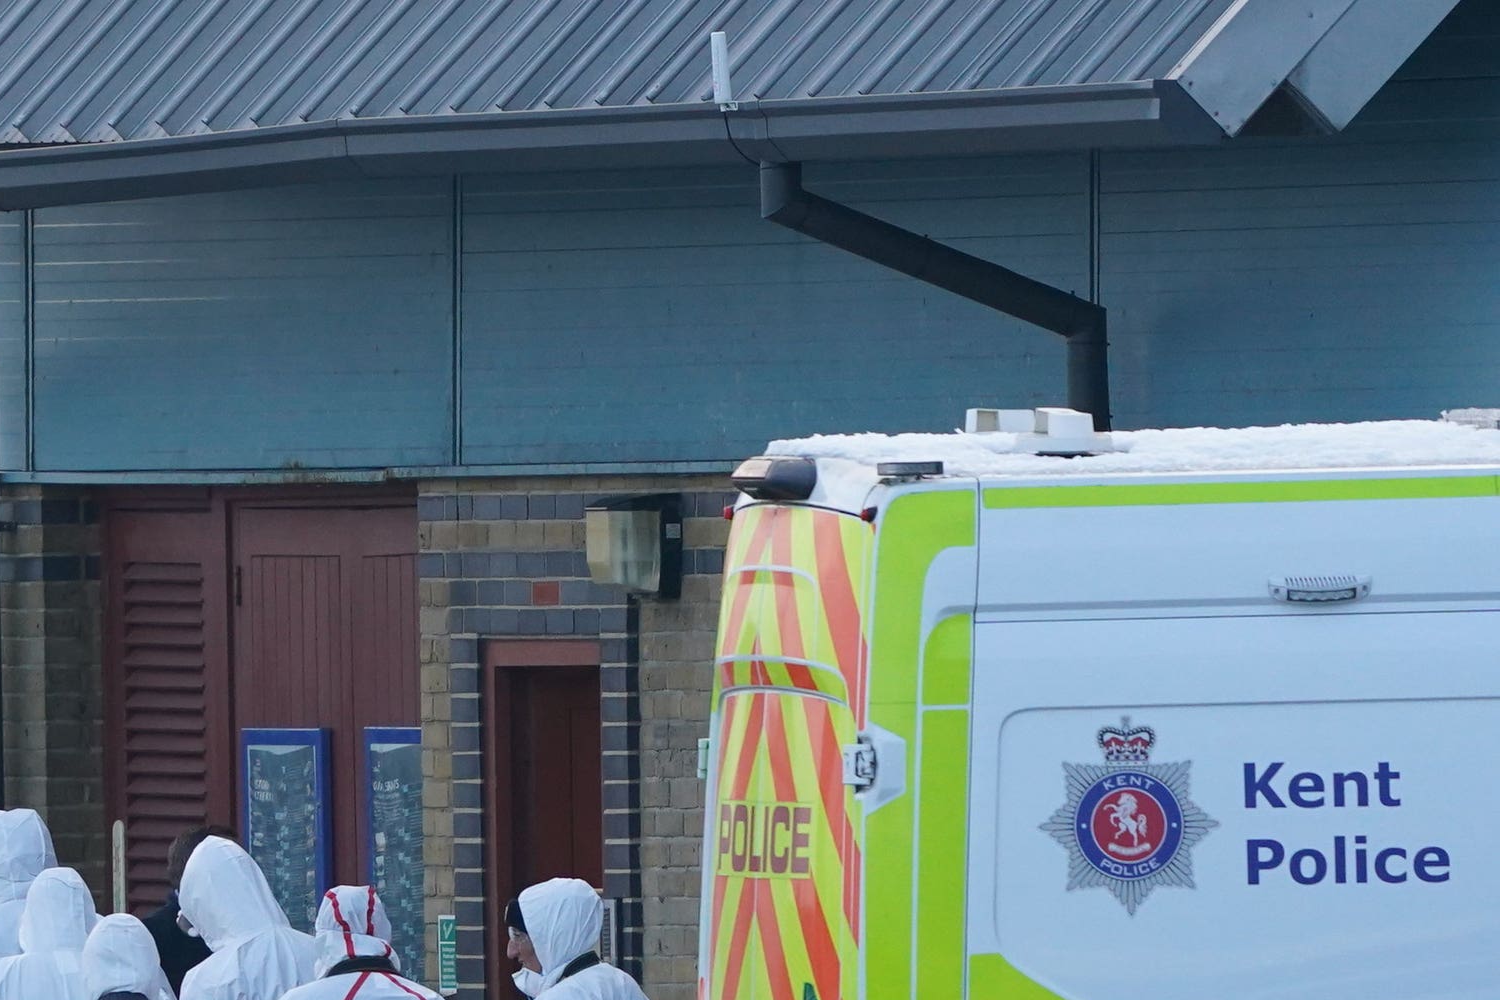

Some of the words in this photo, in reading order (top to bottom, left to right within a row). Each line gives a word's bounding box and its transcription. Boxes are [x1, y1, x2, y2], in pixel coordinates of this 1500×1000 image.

[1102, 775, 1155, 791] KENT
[1243, 761, 1401, 808] Kent
[718, 804, 811, 874] POLICE
[1246, 835, 1450, 885] Police
[1100, 857, 1160, 876] POLICE
